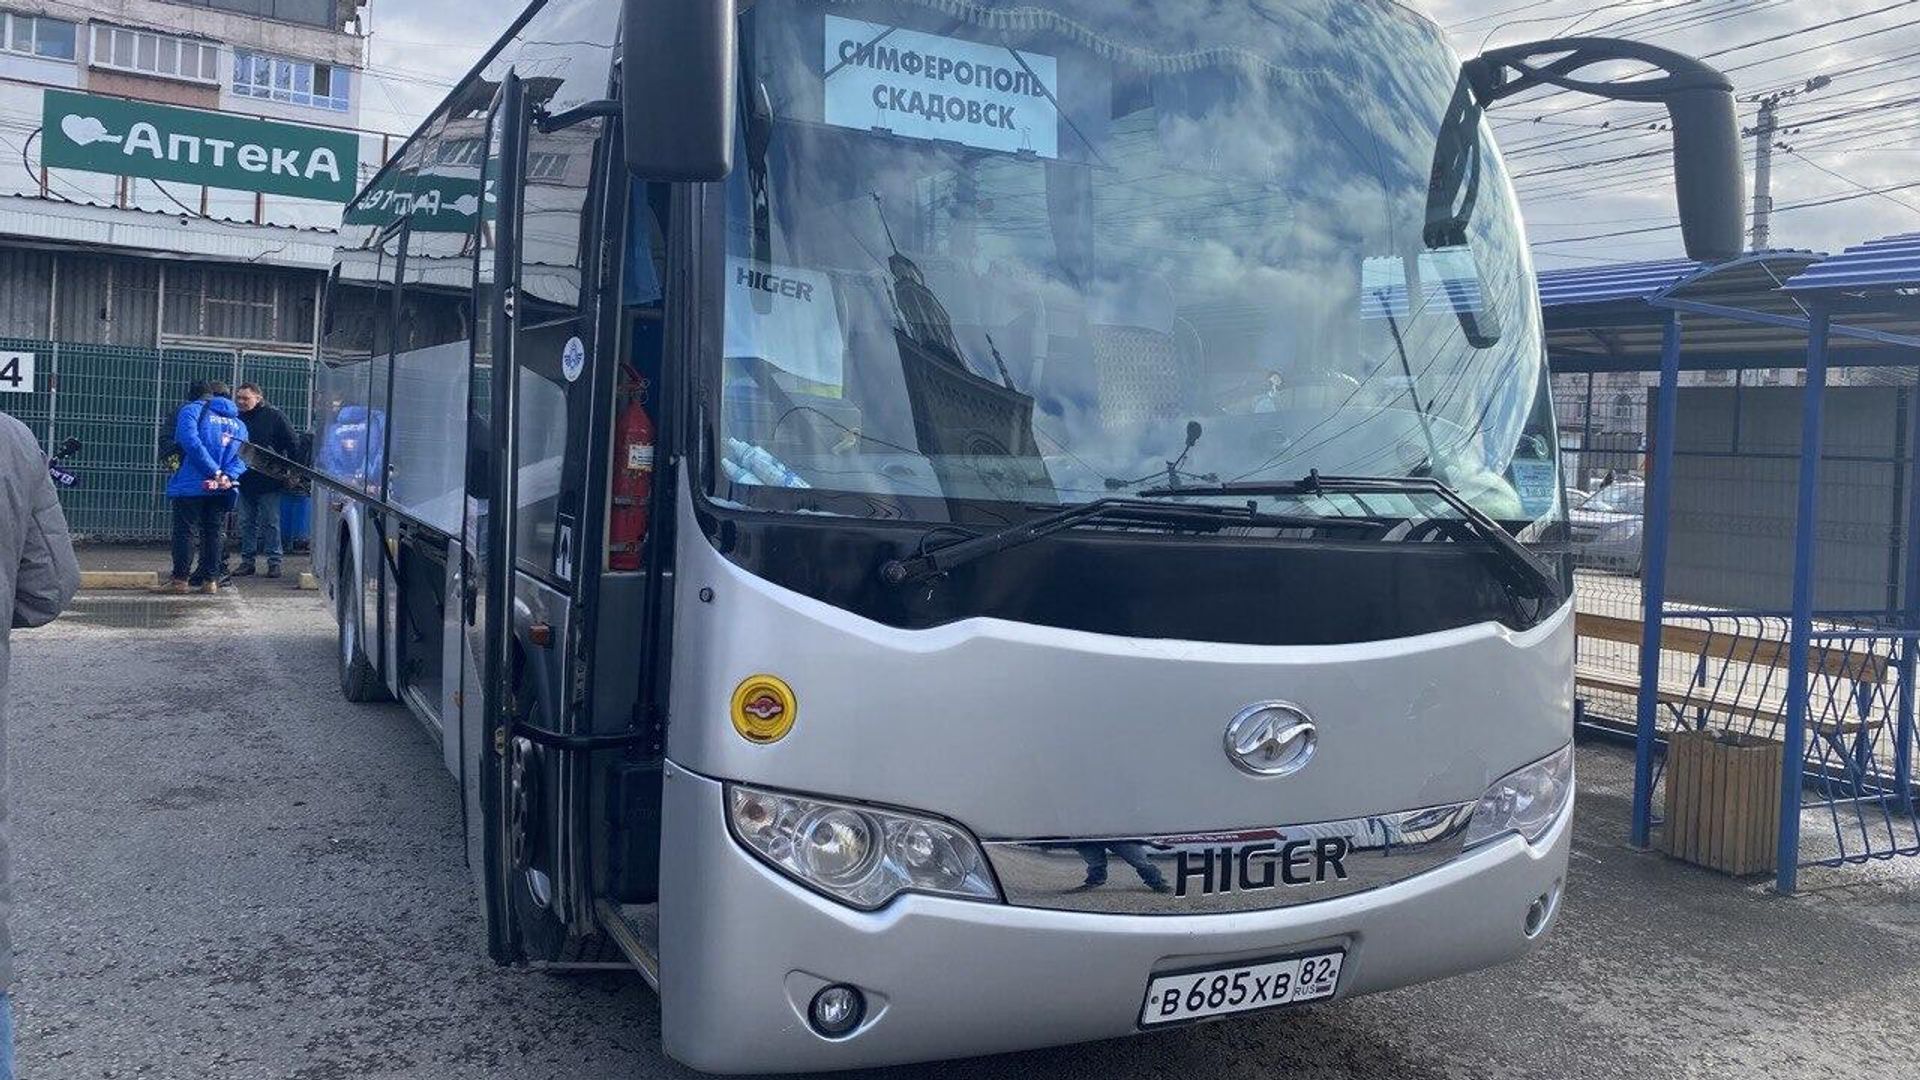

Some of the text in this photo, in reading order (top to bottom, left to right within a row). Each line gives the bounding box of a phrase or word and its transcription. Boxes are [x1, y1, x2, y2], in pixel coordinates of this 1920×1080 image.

[839, 39, 1047, 98] СИМФЕРОПОЛЬ
[872, 84, 1016, 130] СКАДОВСК
[736, 266, 814, 303] HIGER
[0, 357, 23, 388] 4
[1175, 835, 1350, 898] HIGER
[1295, 984, 1316, 996] RUS
[1300, 958, 1331, 986] 82
